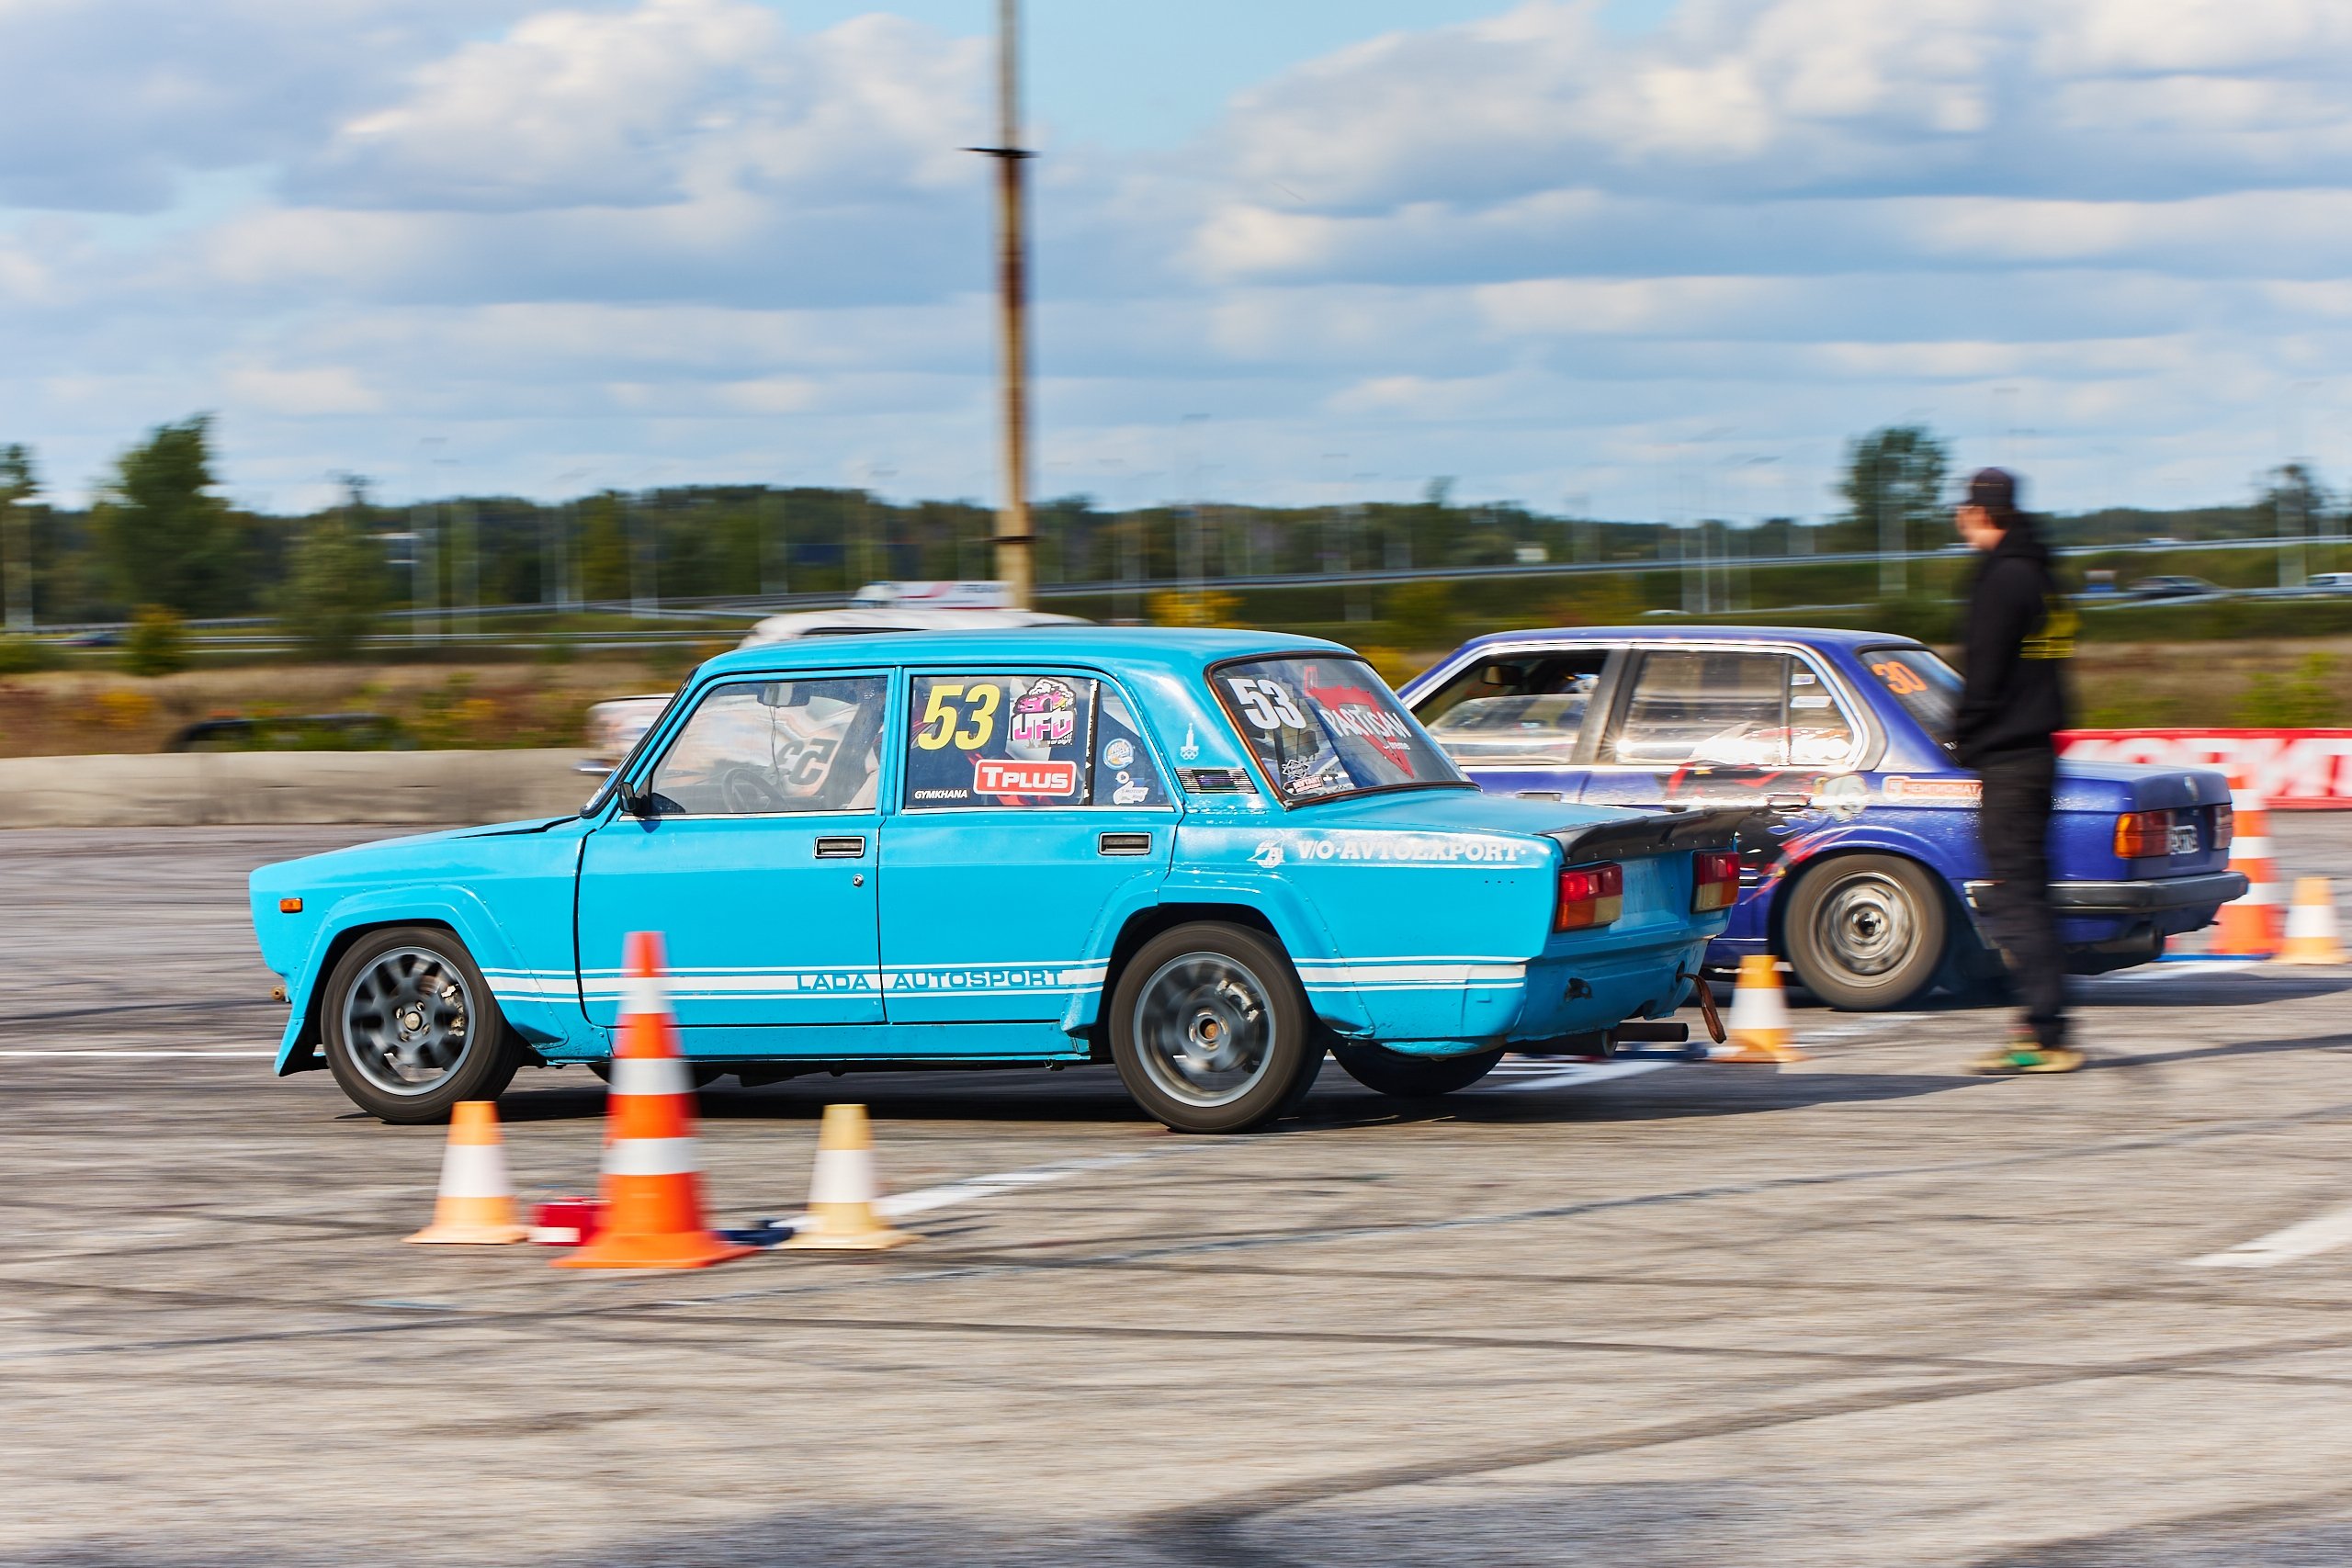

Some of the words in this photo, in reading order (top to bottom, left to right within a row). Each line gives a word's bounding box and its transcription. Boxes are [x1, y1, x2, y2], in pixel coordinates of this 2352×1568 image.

[1871, 661, 1928, 694] 30
[919, 684, 1001, 750] 53
[1227, 679, 1306, 729] 53
[1319, 705, 1412, 738] PARTISAN
[914, 789, 967, 799] GYMKHANA
[797, 974, 871, 990] LADA
[893, 969, 1064, 989] AUTOSPORT
